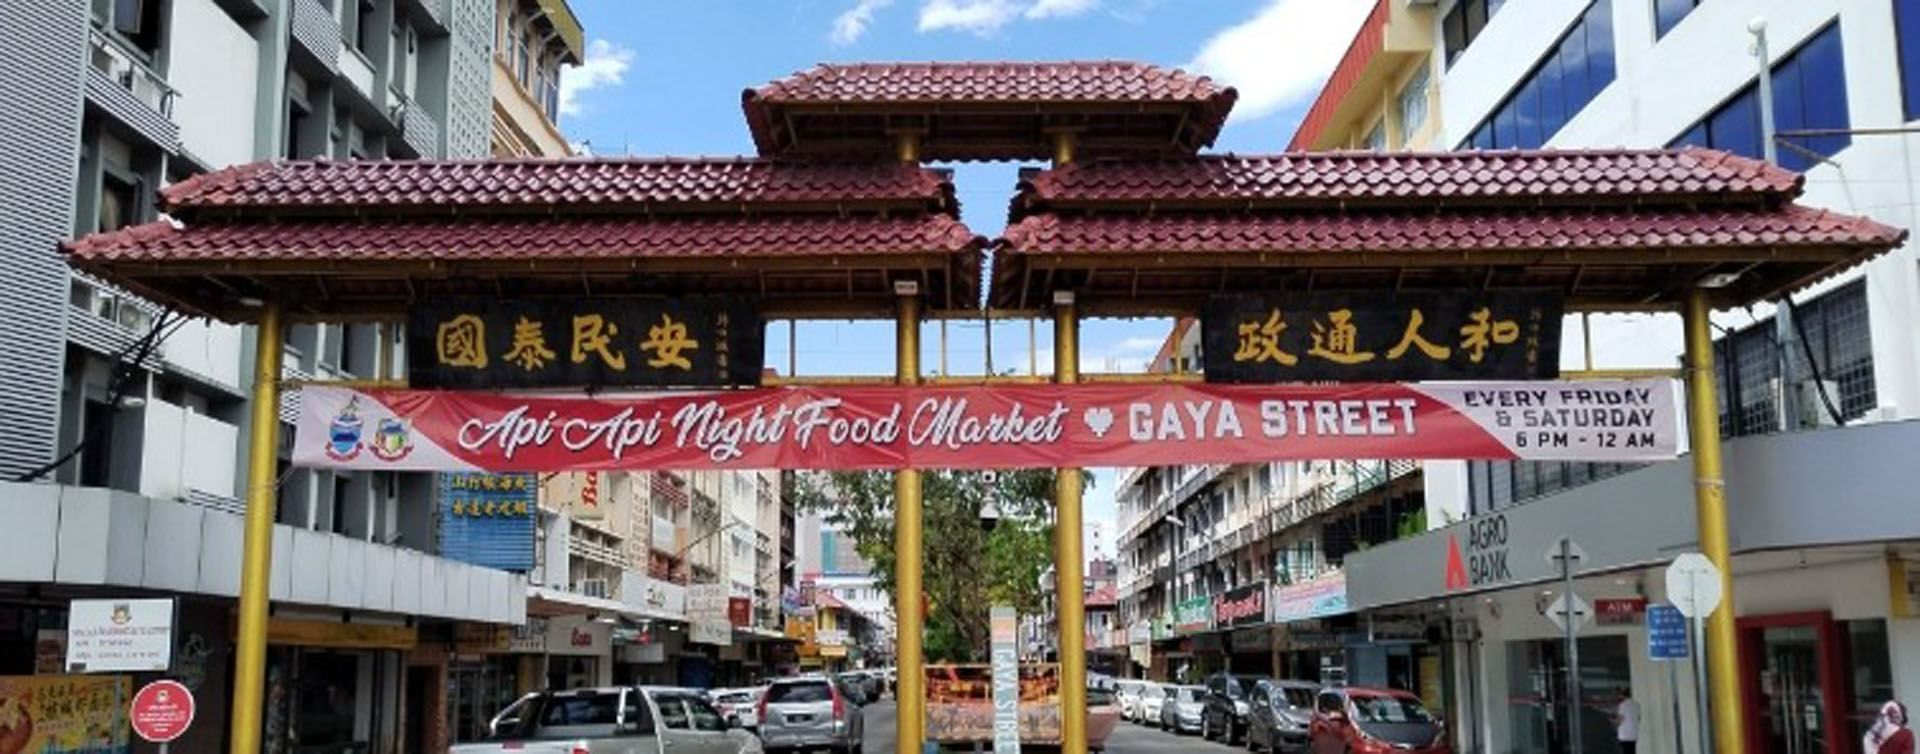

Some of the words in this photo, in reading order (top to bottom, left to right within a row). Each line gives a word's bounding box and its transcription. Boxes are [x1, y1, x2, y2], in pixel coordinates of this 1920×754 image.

[436, 312, 699, 372] 國泰民安
[1233, 307, 1520, 367] 政通人和
[1463, 390, 1547, 407] EVERY
[1559, 388, 1651, 405] FRIDAY
[458, 404, 556, 460] Api
[561, 406, 662, 460] Api
[671, 399, 791, 461] Night
[793, 397, 901, 450] Food
[908, 396, 1069, 450] Market
[1128, 400, 1243, 441] GAYA
[1260, 398, 1417, 437] STREET
[1495, 410, 1511, 428] &
[1523, 409, 1654, 428] SATURDAY
[1516, 431, 1527, 447] 6
[1538, 432, 1568, 447] PM
[1597, 432, 1616, 447] 12
[1625, 432, 1655, 447] AM
[1470, 514, 1507, 550] AGRO
[1470, 548, 1512, 585] BANK
[994, 648, 1016, 691] GAYA
[995, 700, 1019, 753] STREE
